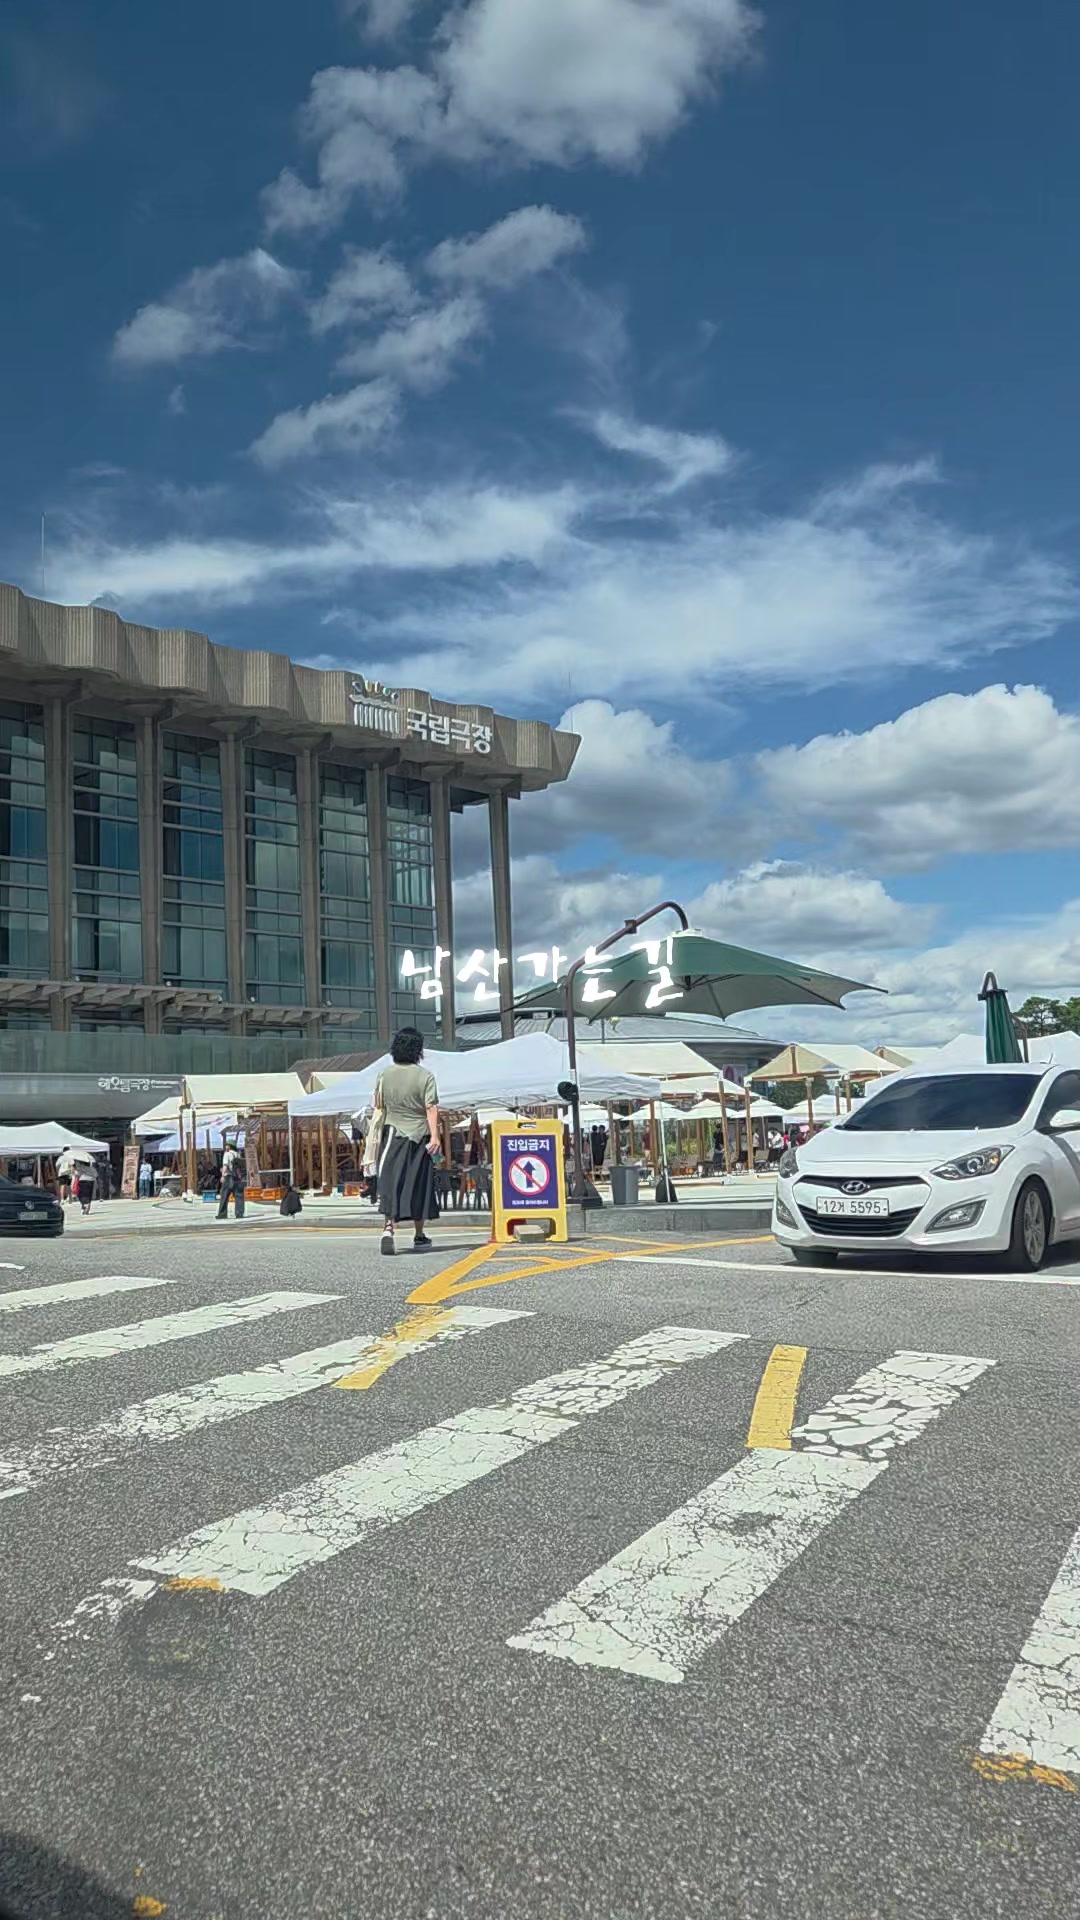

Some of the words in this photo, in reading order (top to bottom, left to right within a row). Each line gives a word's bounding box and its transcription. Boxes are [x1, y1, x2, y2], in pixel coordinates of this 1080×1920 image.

[407, 708, 493, 754] 국립극장
[507, 1139, 550, 1152] 진입금지
[850, 1201, 881, 1214] 5595
